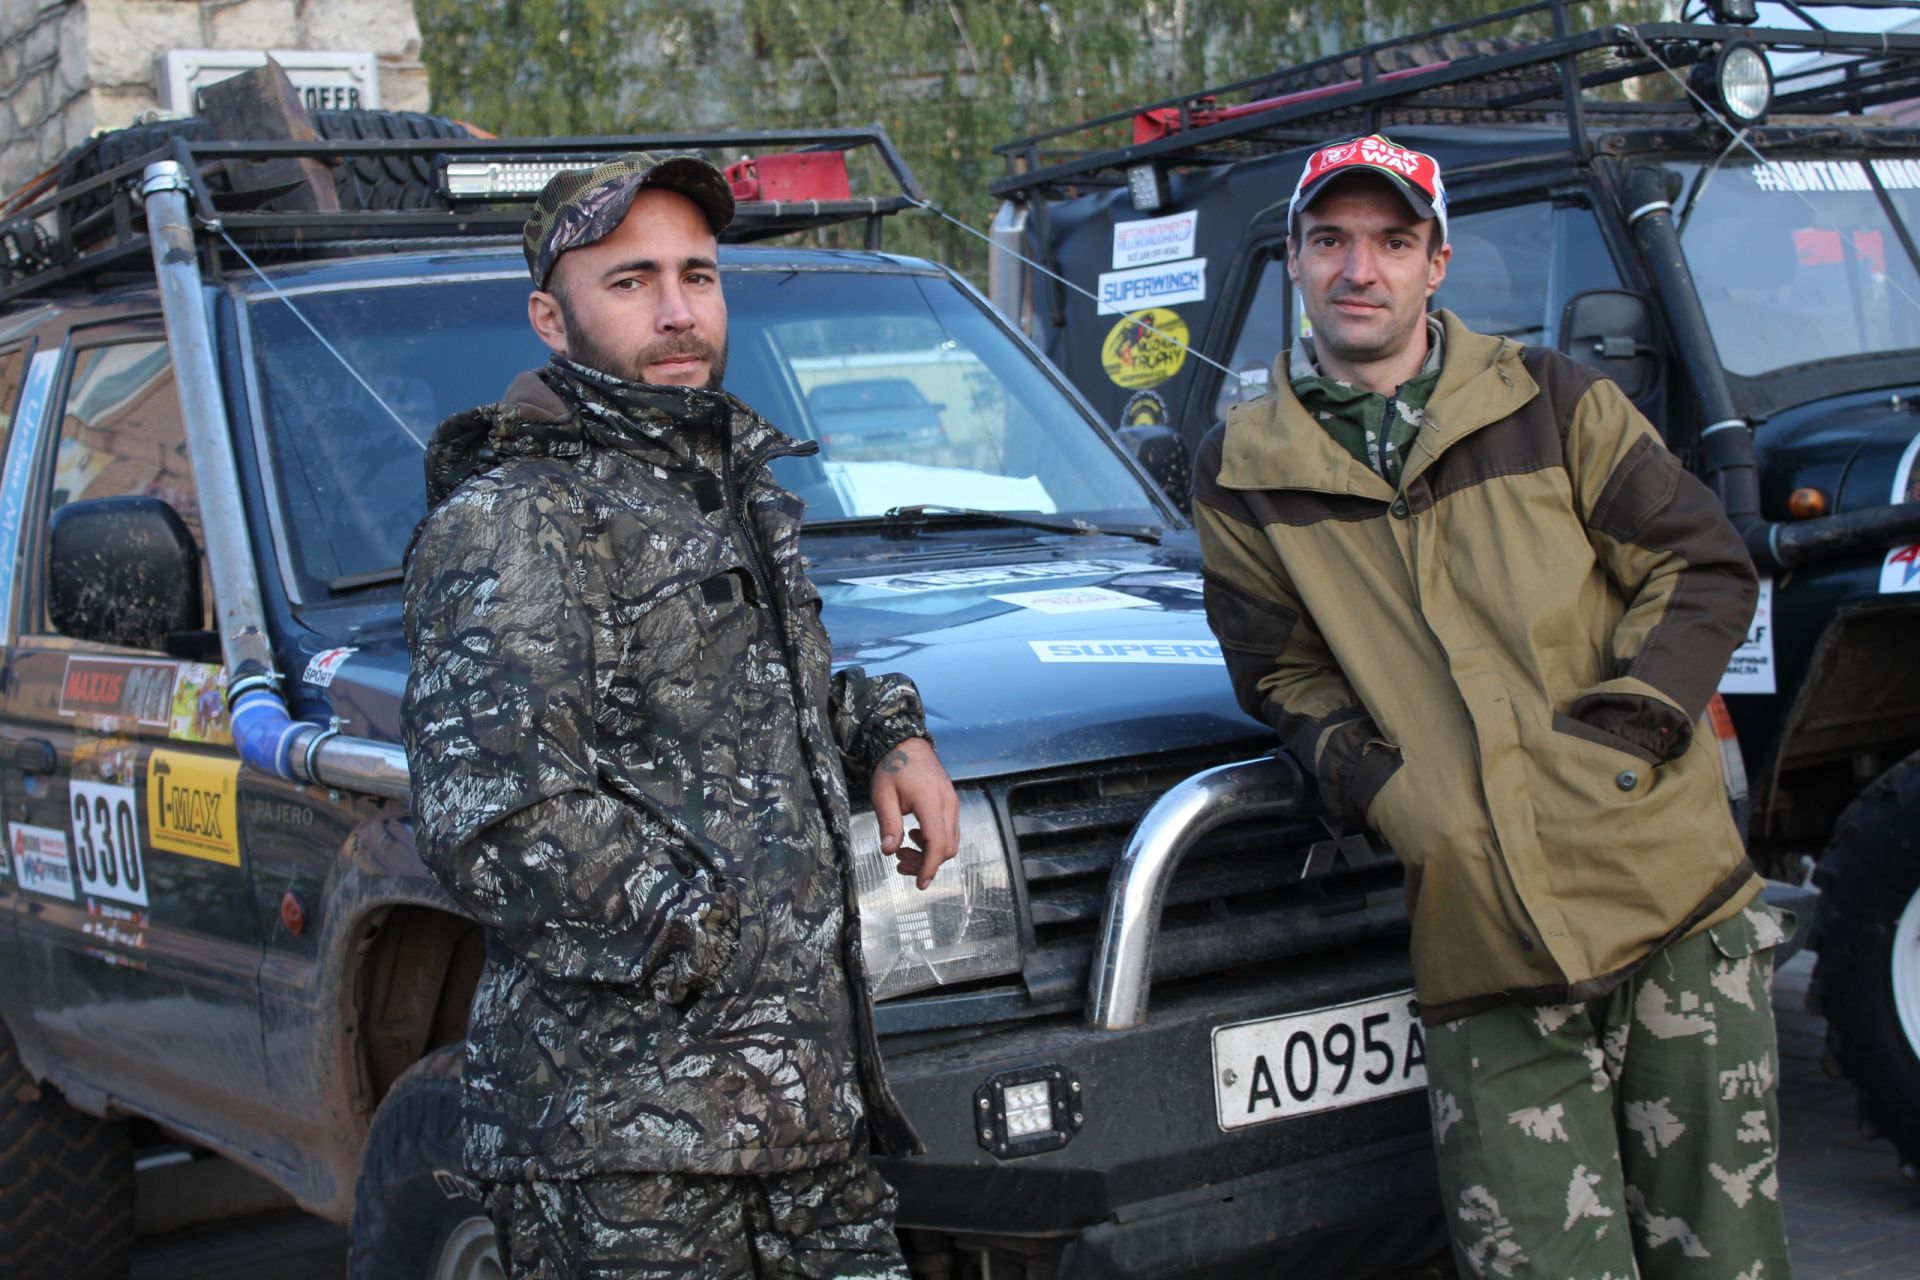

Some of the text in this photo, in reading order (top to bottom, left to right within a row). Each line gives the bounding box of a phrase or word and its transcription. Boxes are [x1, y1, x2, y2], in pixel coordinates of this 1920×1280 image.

[1361, 139, 1420, 166] SILK
[1362, 149, 1418, 176] WAY
[1103, 269, 1200, 303] SUPERWINCH
[65, 671, 124, 704] MAXXIS
[303, 667, 333, 686] SPORT
[153, 759, 223, 839] T-MAX
[254, 799, 314, 828] PAJERO
[74, 793, 140, 893] 330
